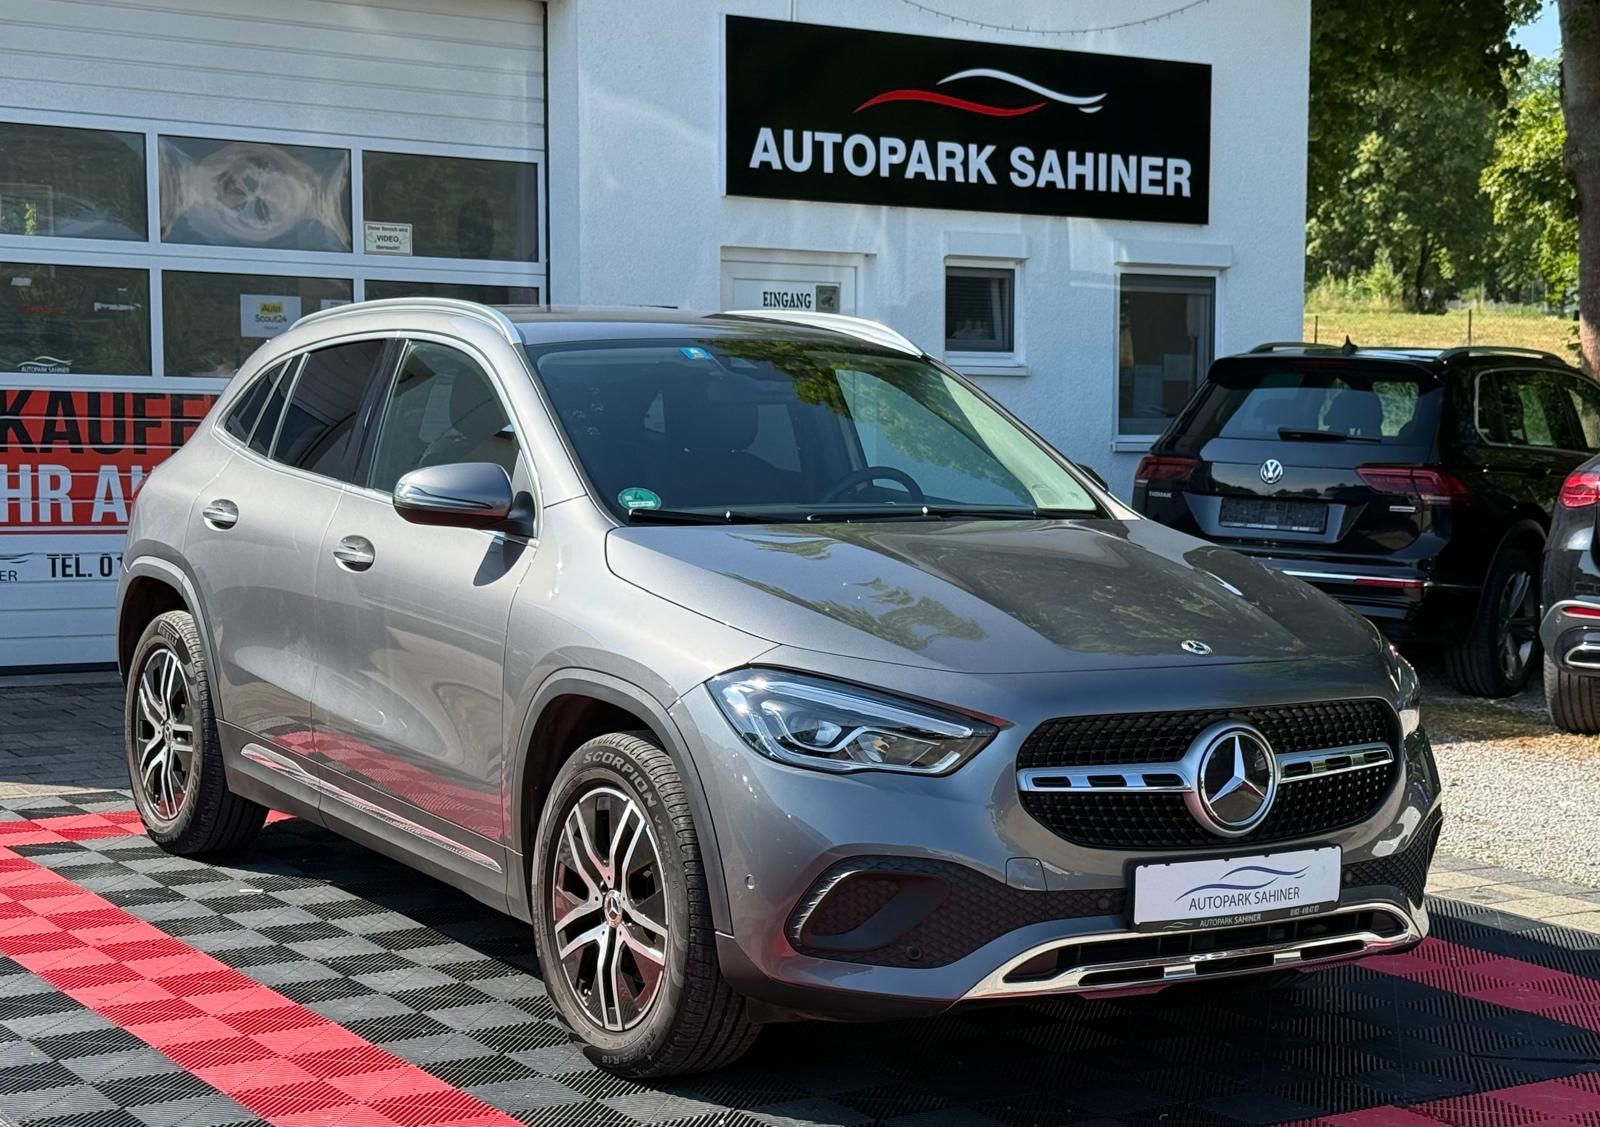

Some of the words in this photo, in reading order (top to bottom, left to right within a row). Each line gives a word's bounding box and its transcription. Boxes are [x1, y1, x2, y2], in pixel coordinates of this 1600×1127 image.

[749, 127, 997, 185] AUTOPARK
[1009, 146, 1192, 197] SAHINER
[376, 235, 399, 243] VIDEO
[261, 303, 282, 314] Auto
[762, 291, 812, 309] EINGANG
[255, 314, 287, 323] Scout24
[47, 554, 92, 578] TEL.
[583, 751, 657, 808] SCORPION
[1189, 892, 1251, 911] AUTOPARK
[1254, 887, 1300, 905] SAHINER
[1200, 917, 1233, 928] AUTOPARK
[1234, 913, 1262, 924] SAHINER
